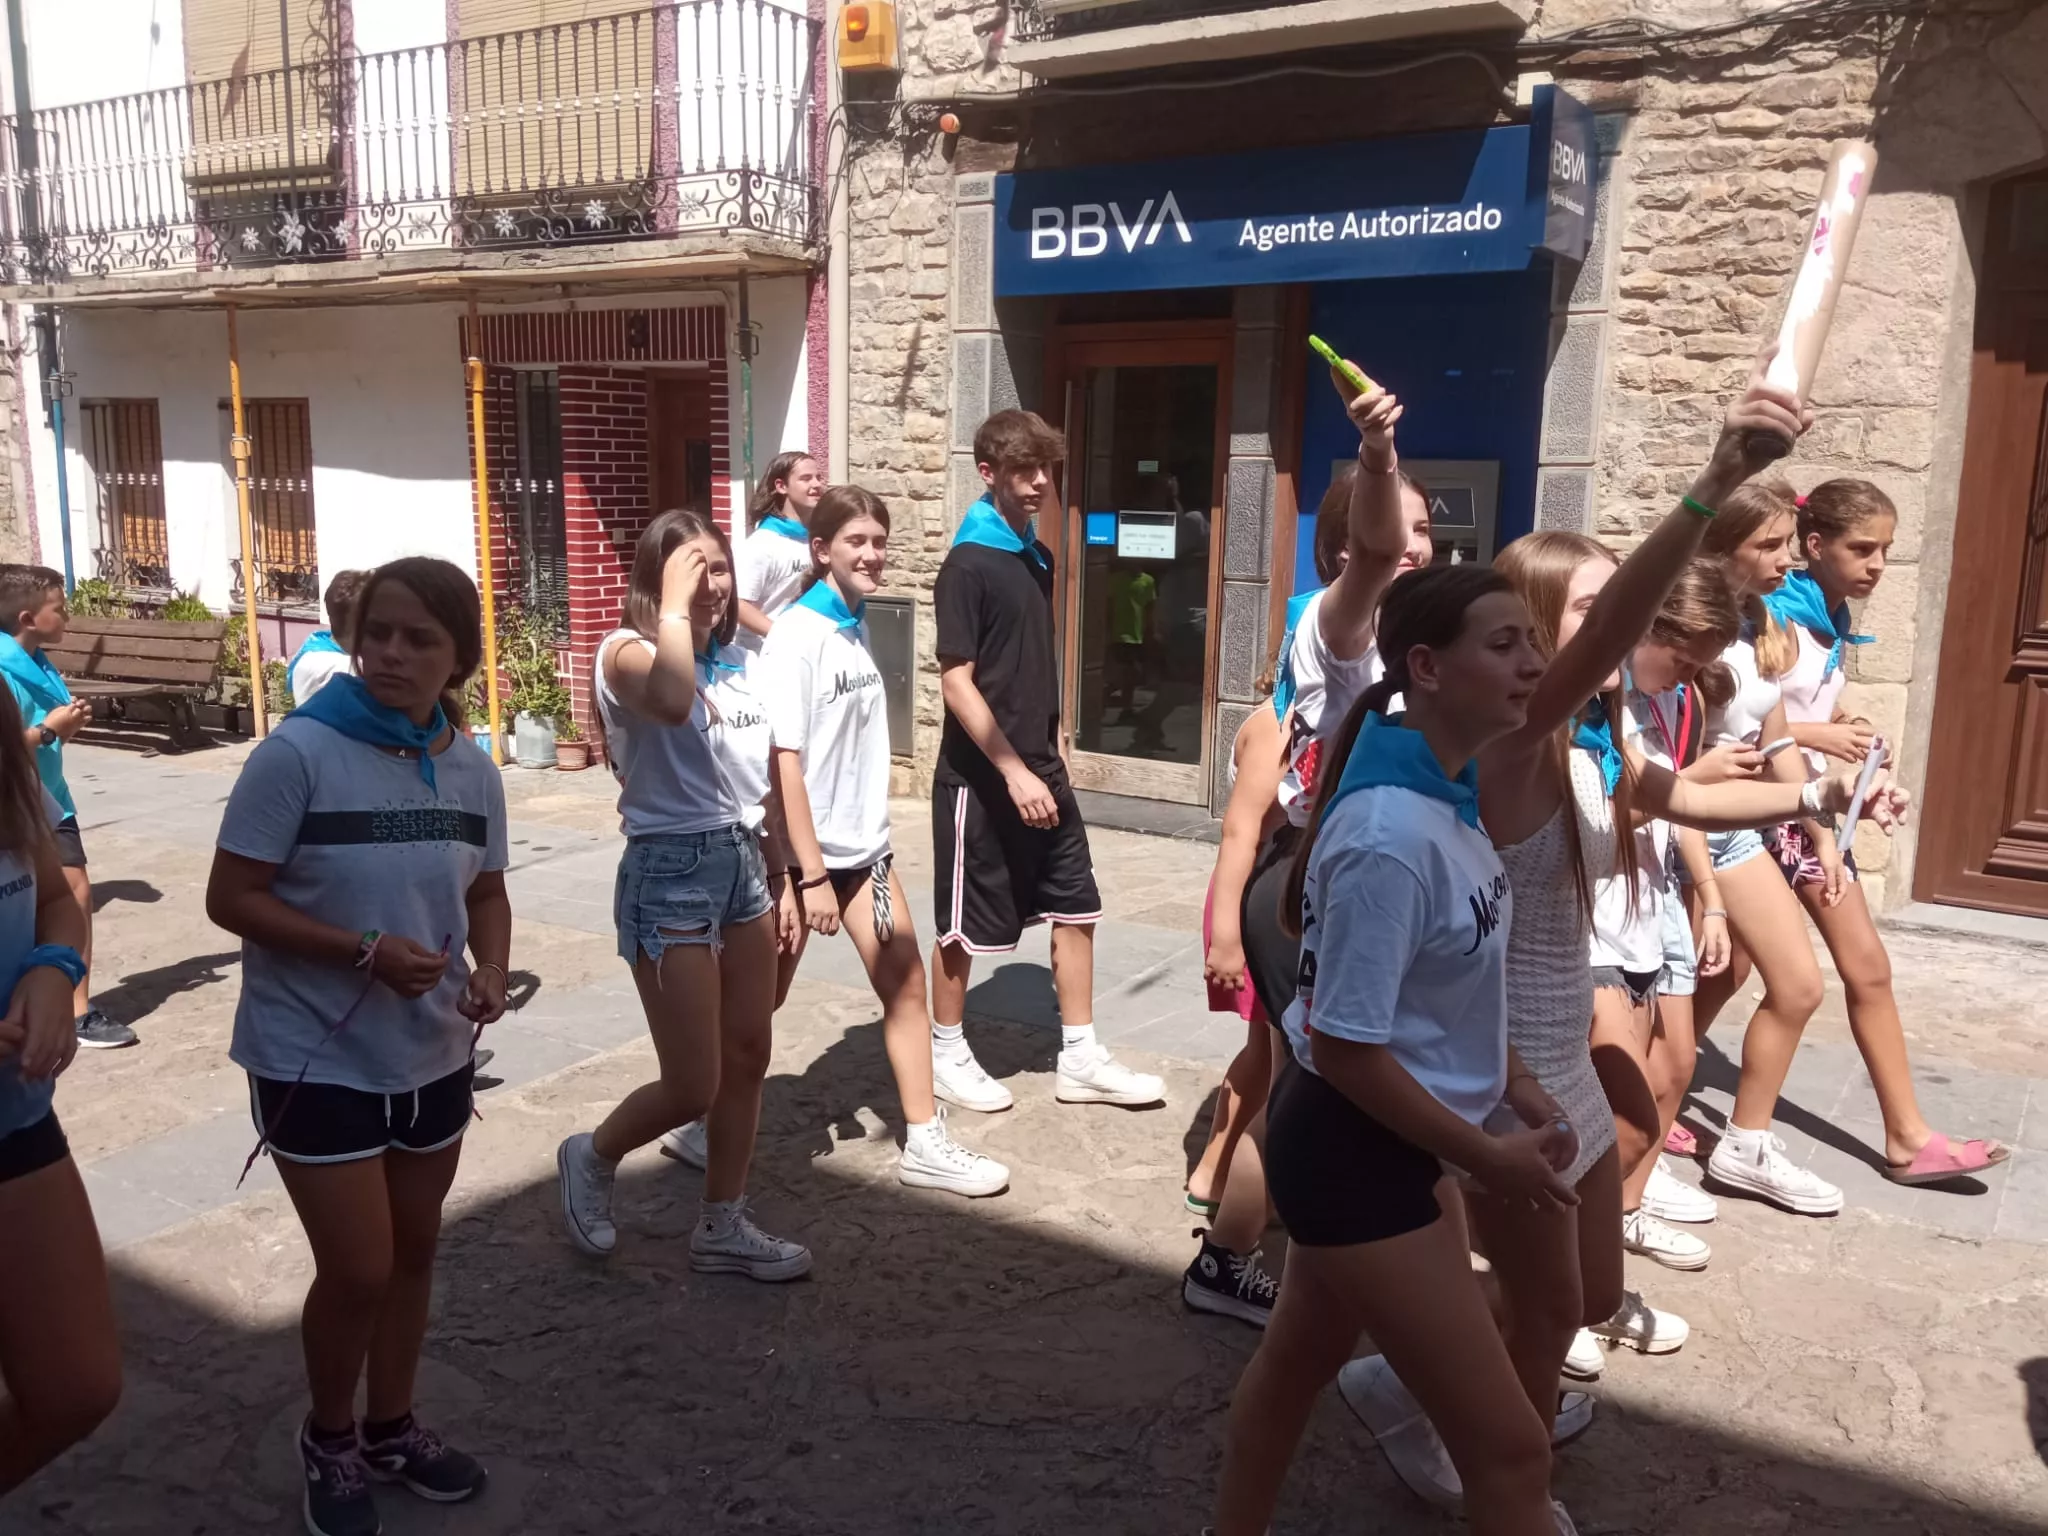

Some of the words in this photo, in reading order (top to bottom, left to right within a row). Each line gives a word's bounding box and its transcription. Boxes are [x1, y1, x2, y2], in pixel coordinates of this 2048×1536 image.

[1553, 140, 1586, 184] BBVA
[1031, 190, 1192, 259] BBVA
[1238, 217, 1335, 248] Agente
[1340, 202, 1502, 241] Autorizado
